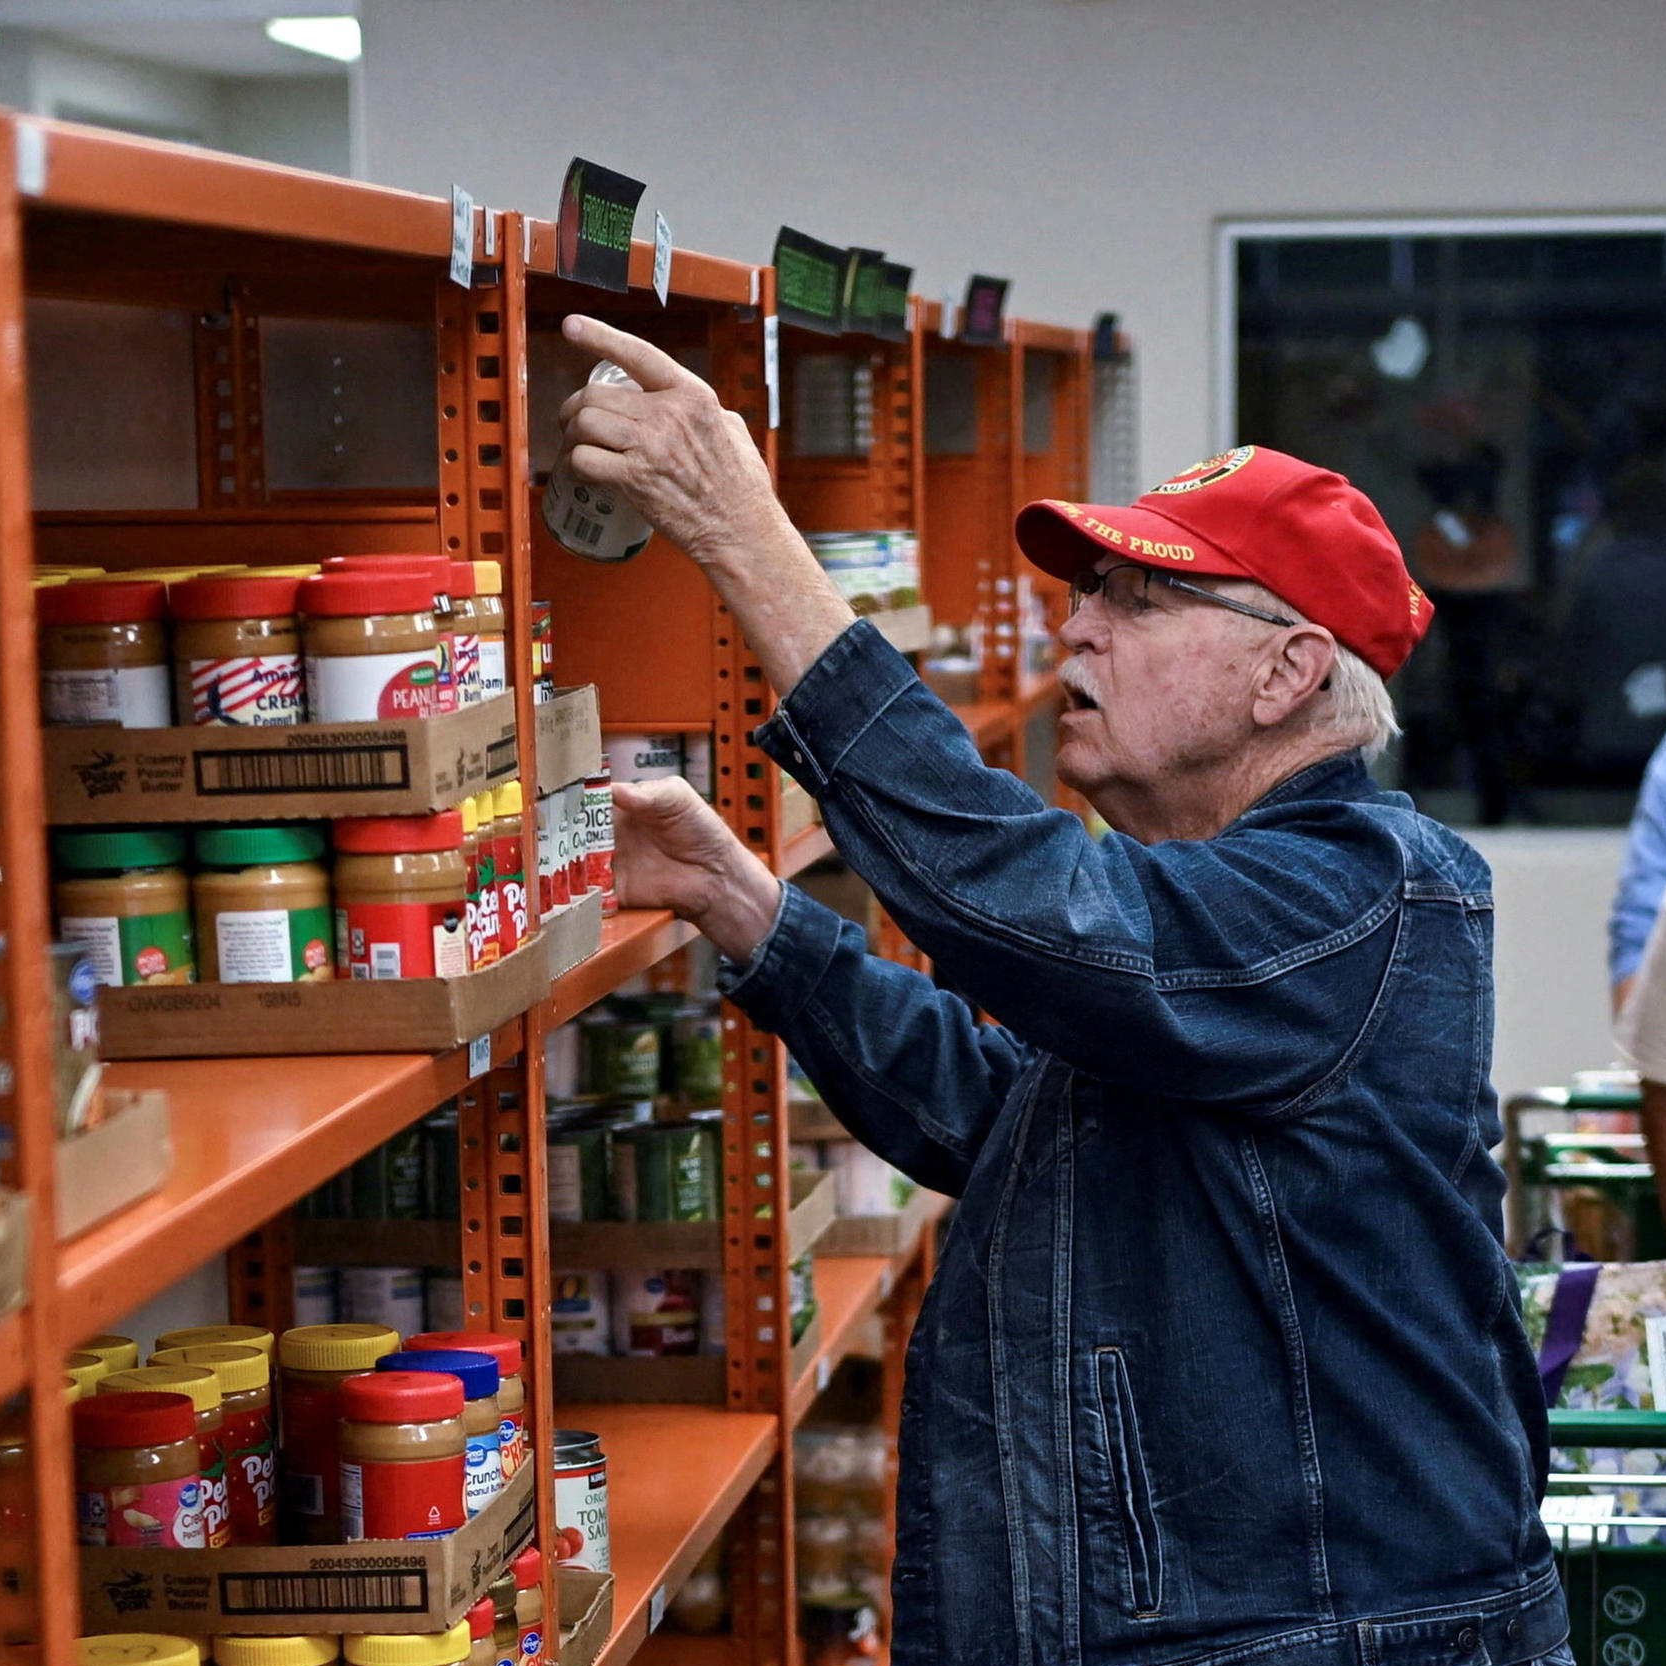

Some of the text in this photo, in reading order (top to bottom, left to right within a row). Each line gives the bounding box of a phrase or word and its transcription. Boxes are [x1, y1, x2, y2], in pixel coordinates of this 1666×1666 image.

[1083, 518, 1123, 545] THE
[1129, 536, 1195, 561] PROUD
[309, 1556, 427, 1571] 20045300005496
